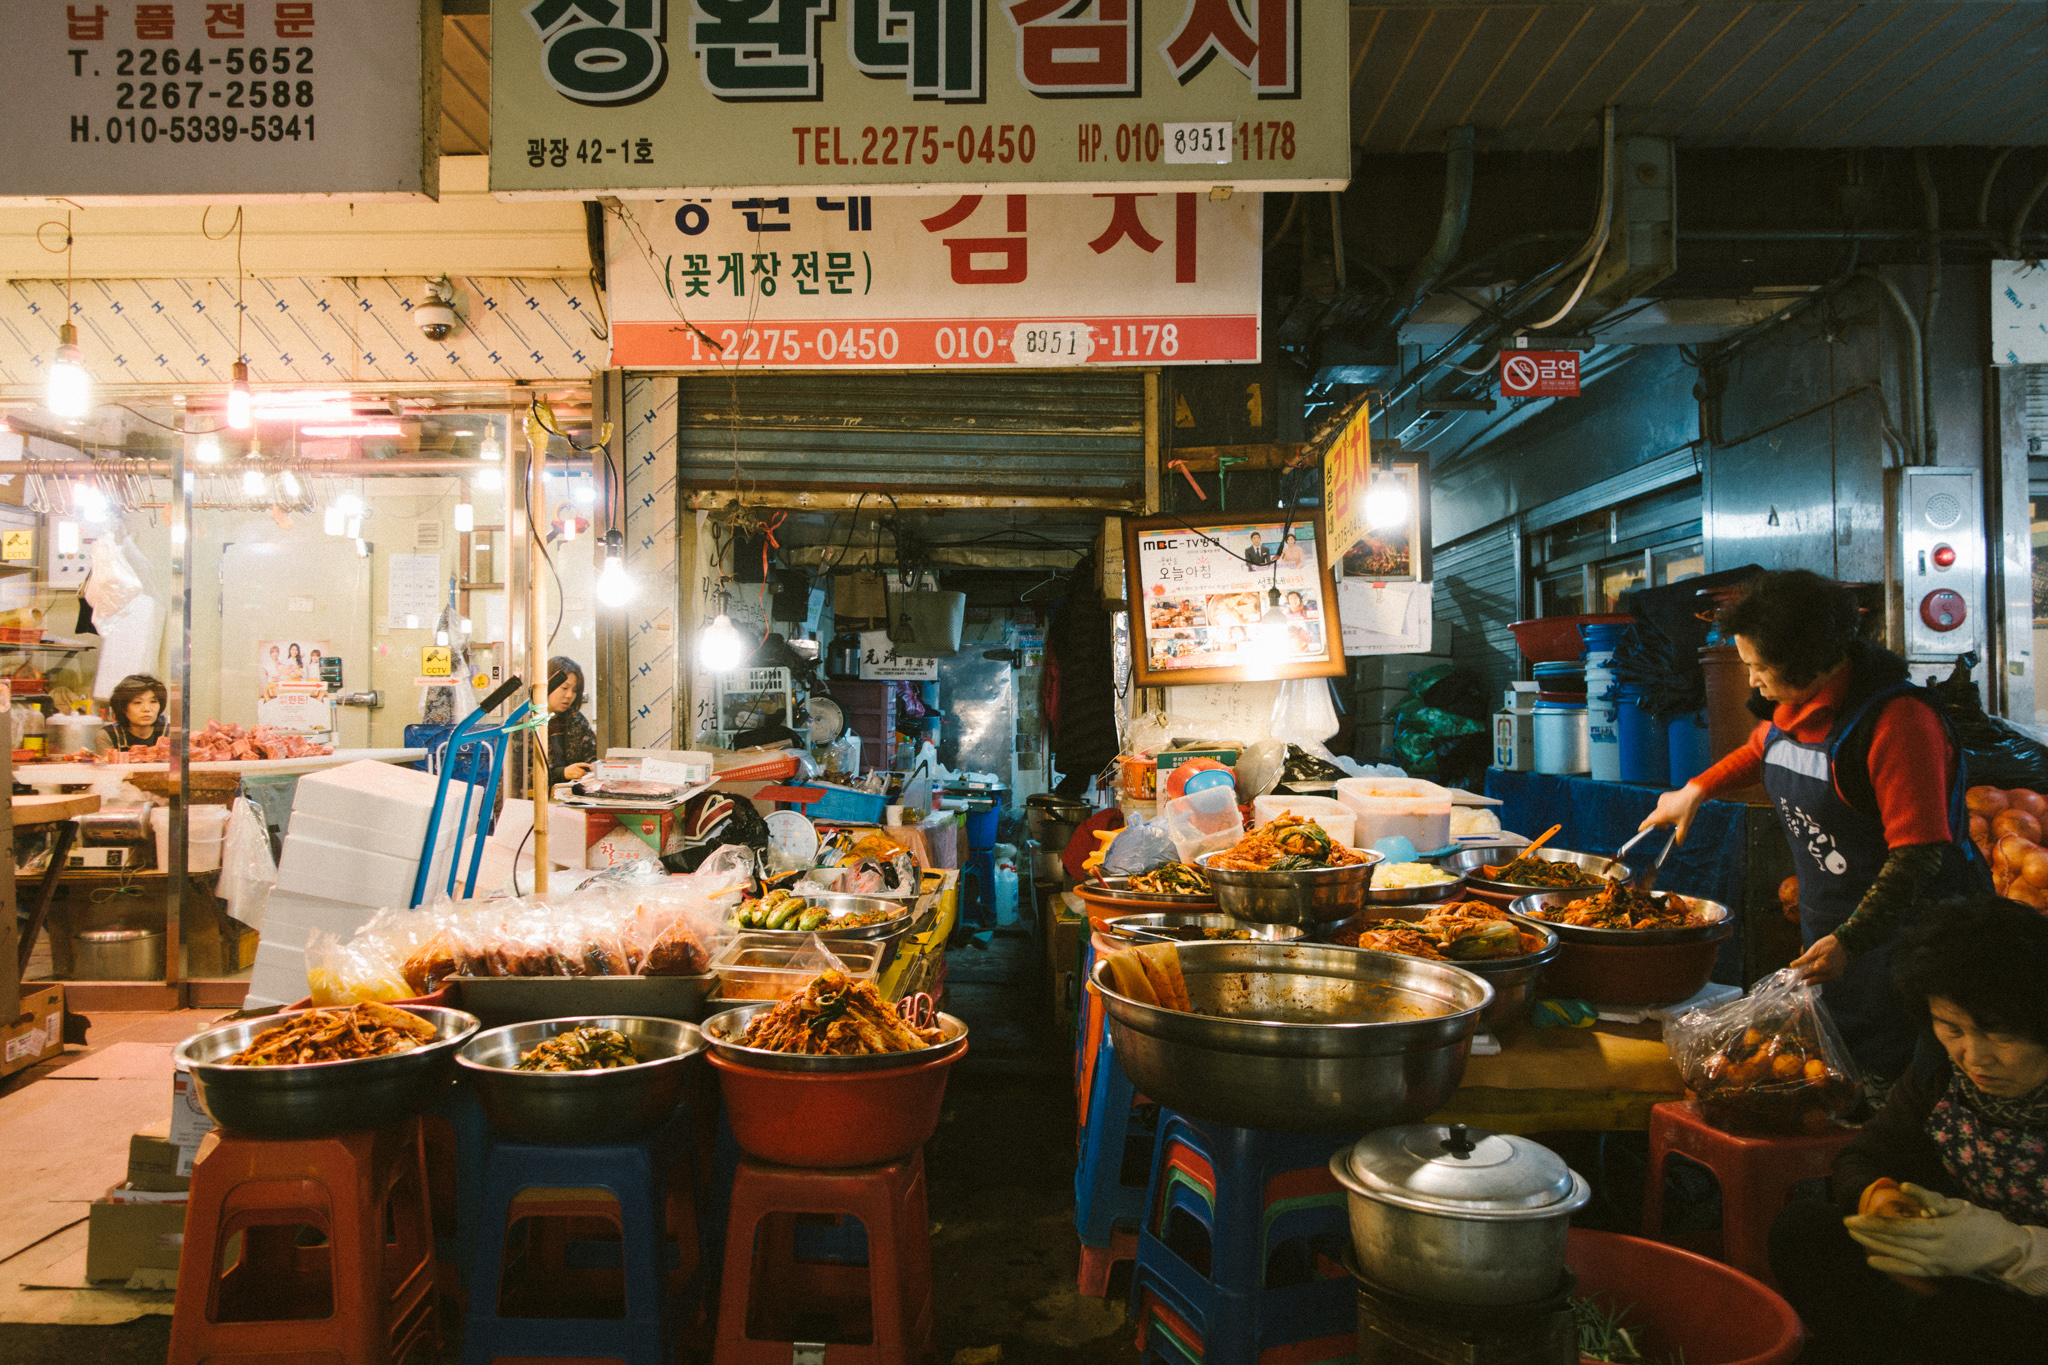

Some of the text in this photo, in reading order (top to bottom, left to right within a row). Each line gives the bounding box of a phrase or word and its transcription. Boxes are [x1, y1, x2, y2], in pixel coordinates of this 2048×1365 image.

[116, 80, 314, 110] 2267-2588
[527, 137, 654, 168] 광장 42-1호
[1539, 359, 1576, 379] 금연
[1334, 415, 1369, 521] 김치
